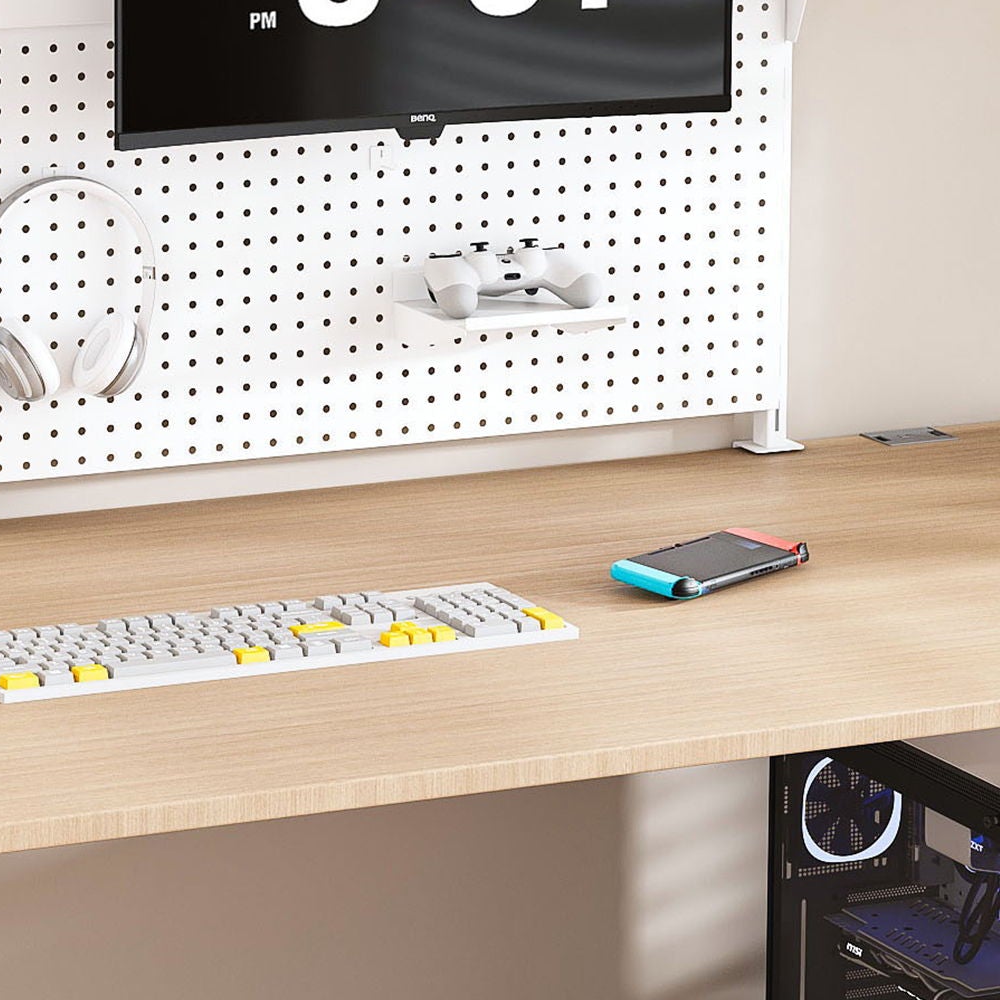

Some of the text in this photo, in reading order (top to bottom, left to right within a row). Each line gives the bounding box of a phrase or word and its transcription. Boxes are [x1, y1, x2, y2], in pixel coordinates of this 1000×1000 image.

[249, 12, 277, 31] PM
[410, 113, 437, 123] BenQ
[970, 840, 984, 852] ZXT
